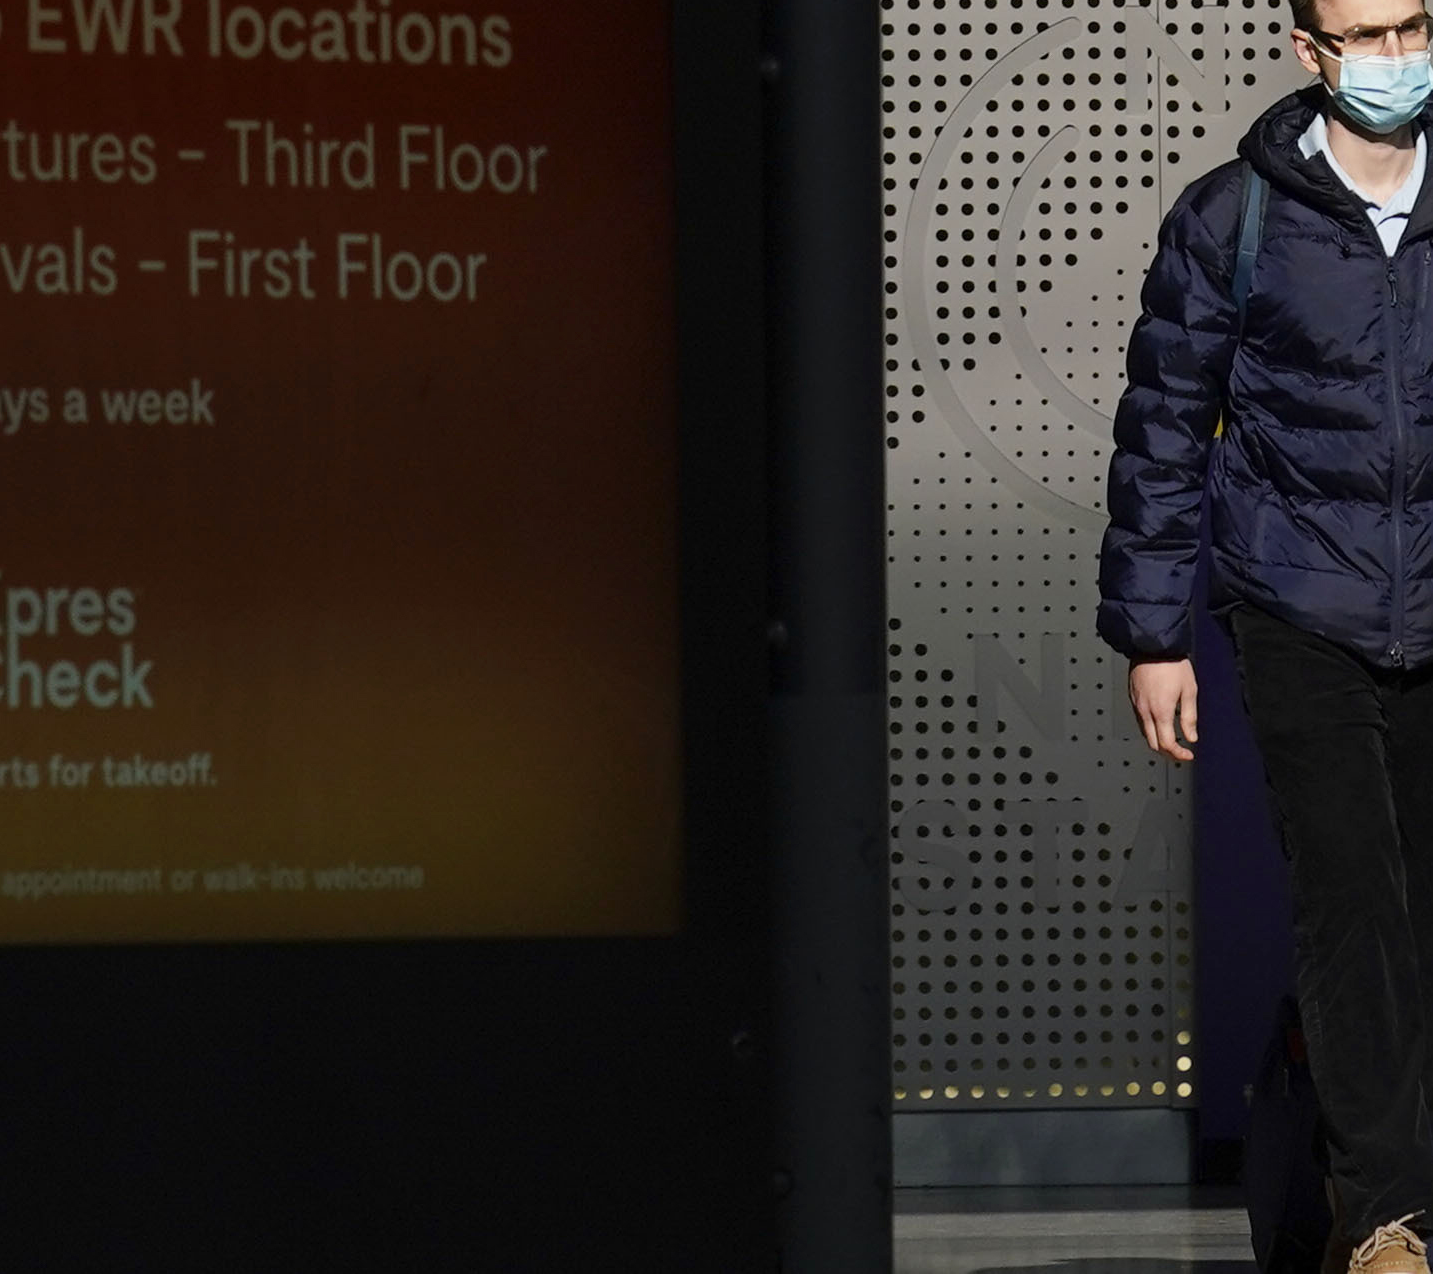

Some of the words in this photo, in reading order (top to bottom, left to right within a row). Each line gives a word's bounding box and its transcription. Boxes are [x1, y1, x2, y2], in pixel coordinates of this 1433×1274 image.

[227, 120, 375, 189] Third
[399, 124, 546, 193] Floor
[189, 230, 315, 298] First
[337, 233, 486, 301] Floor
[63, 388, 87, 422] a
[102, 378, 213, 424] week
[48, 753, 93, 790] for
[101, 751, 218, 790] takeoff.
[1, 864, 162, 899] appointment
